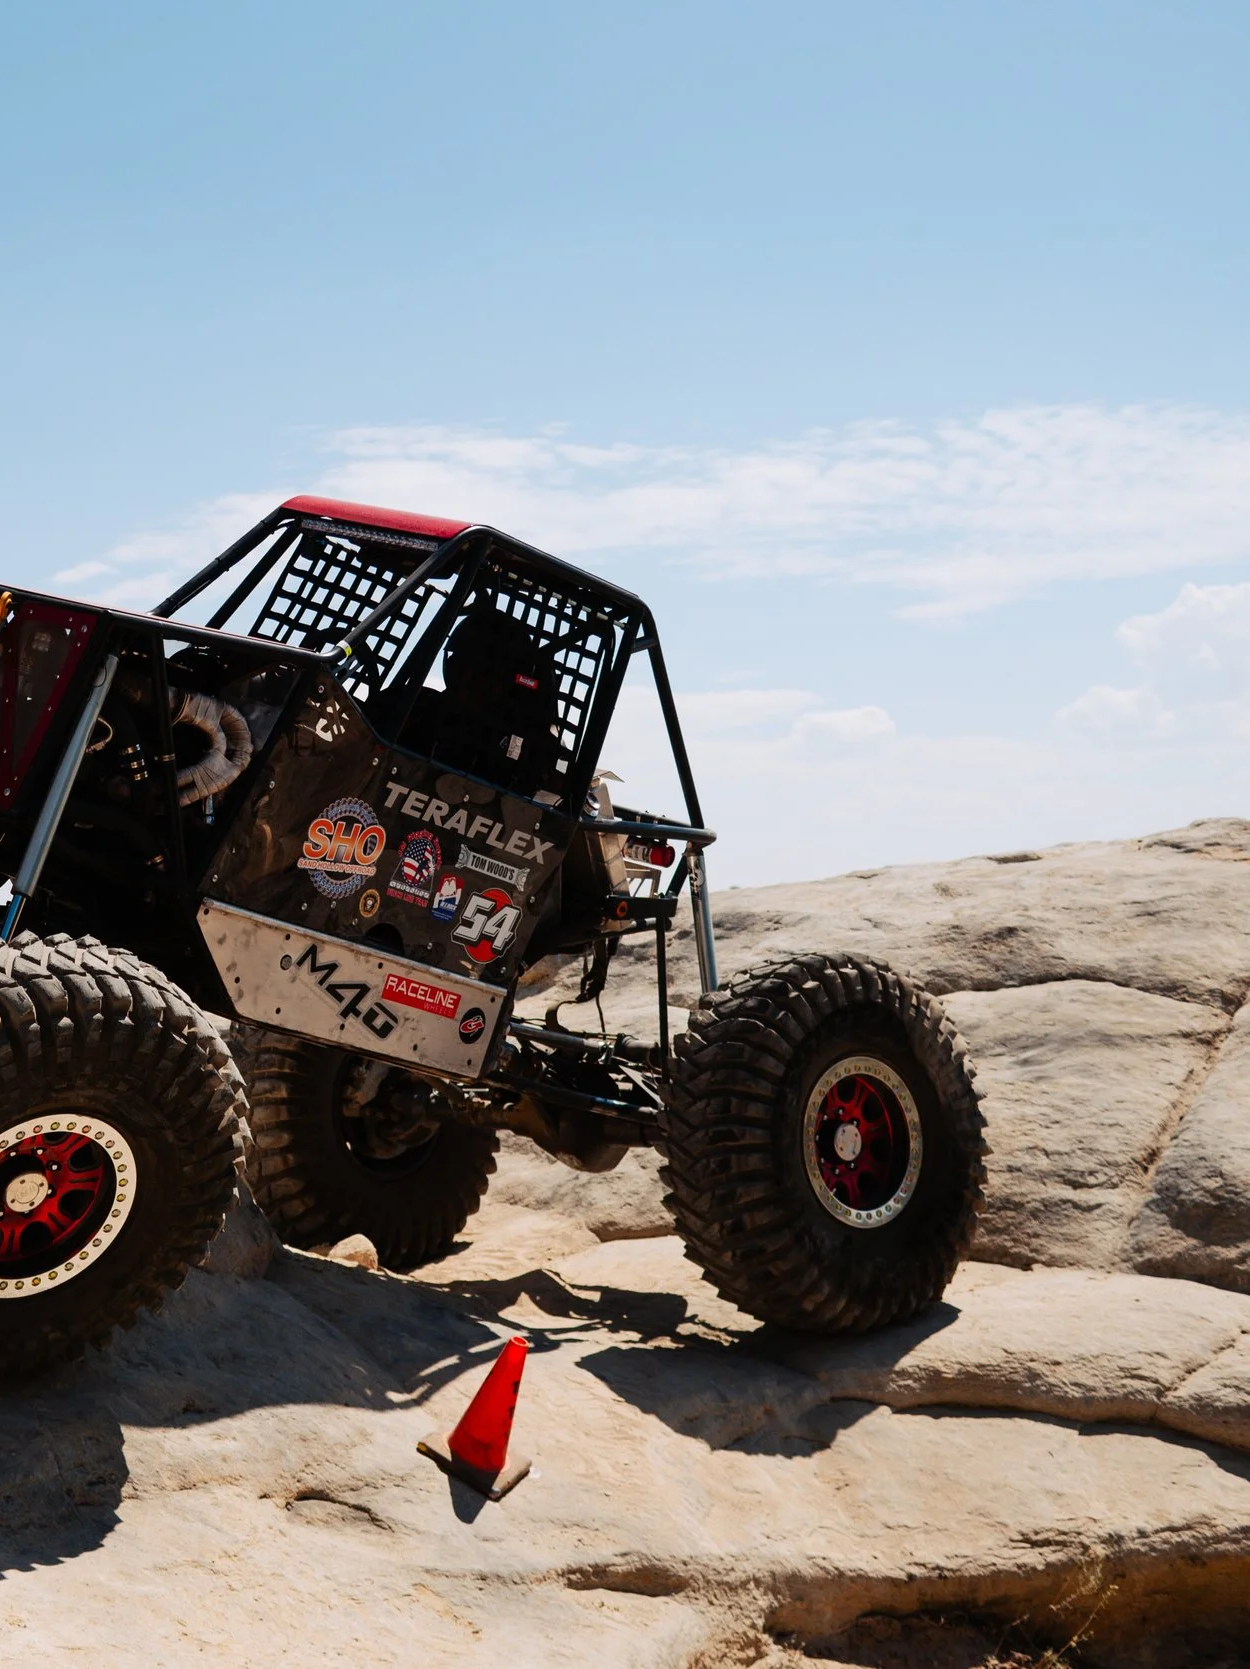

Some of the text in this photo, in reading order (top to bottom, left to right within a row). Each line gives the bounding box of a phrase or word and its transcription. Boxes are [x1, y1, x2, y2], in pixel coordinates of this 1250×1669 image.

[384, 781, 555, 865] TERAFLEX
[303, 818, 387, 866] SHO
[297, 858, 377, 876] SAND HOLLOW OFFROAD
[470, 854, 516, 882] TOM WOOD'S
[452, 893, 521, 953] 54
[385, 976, 458, 1009] RACELINE
[423, 1002, 454, 1017] WHEELS
